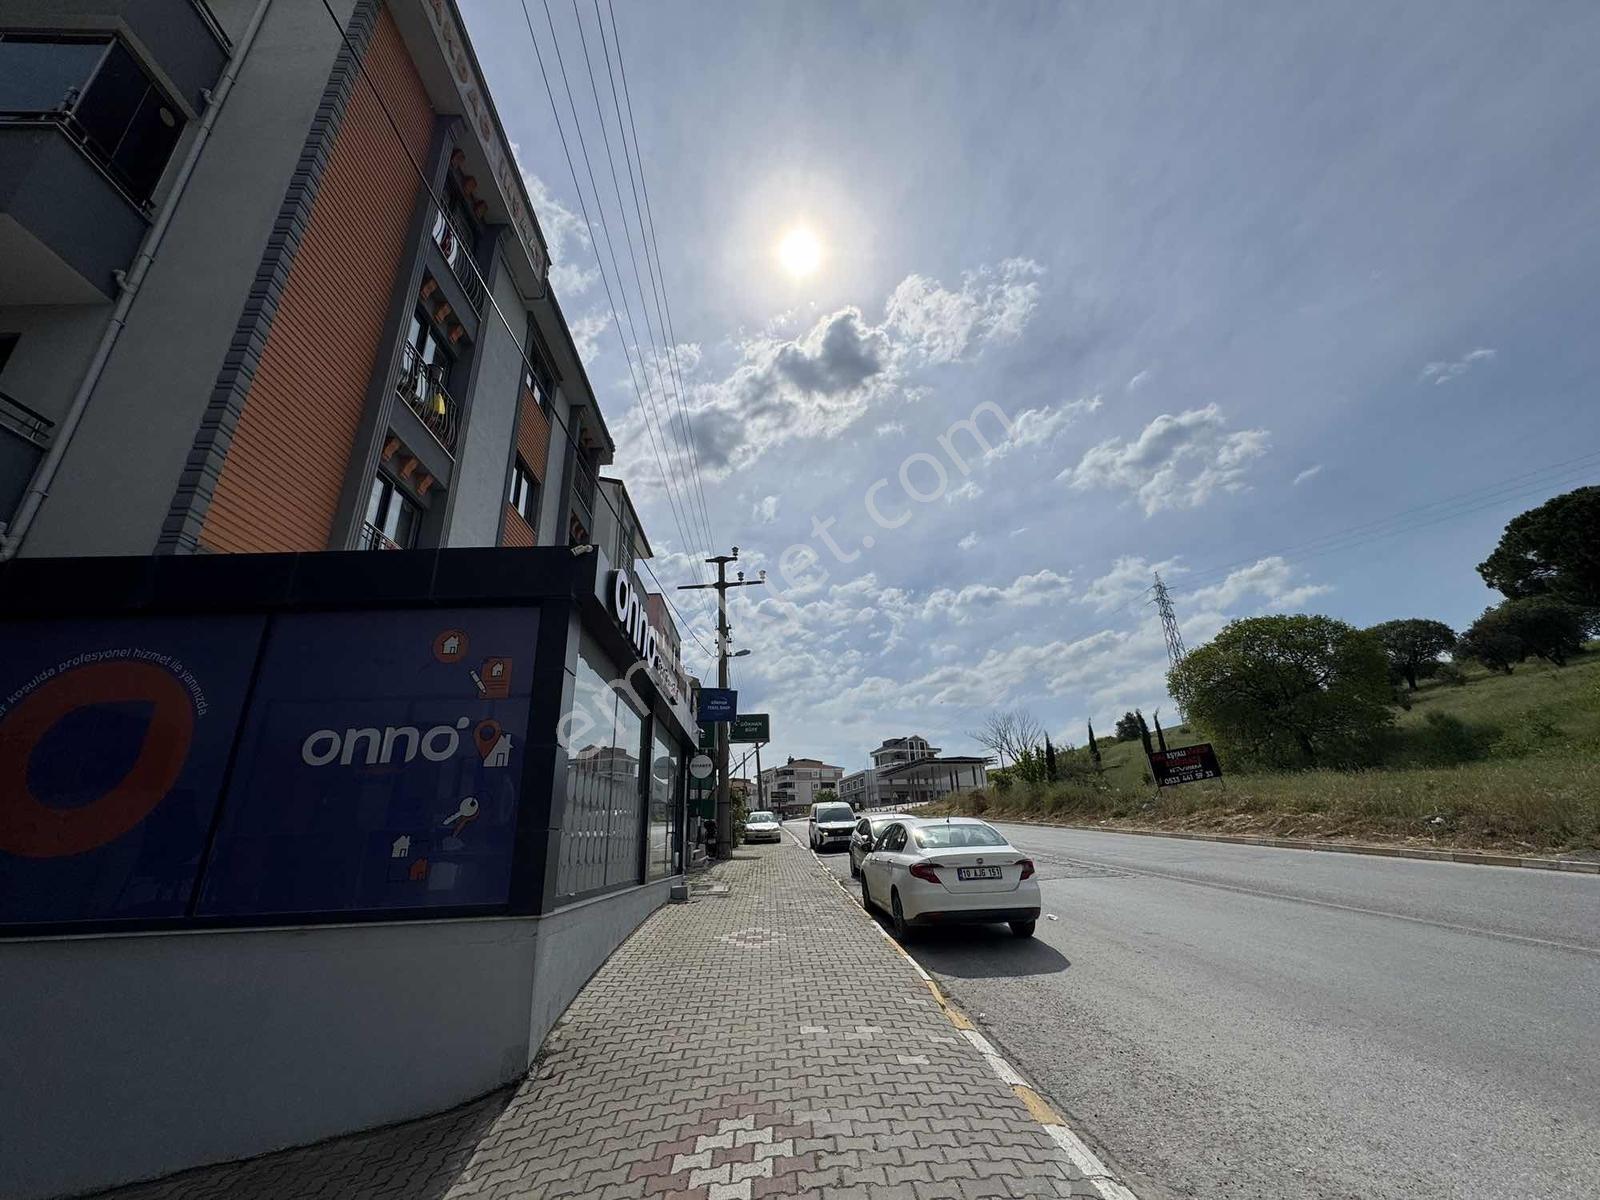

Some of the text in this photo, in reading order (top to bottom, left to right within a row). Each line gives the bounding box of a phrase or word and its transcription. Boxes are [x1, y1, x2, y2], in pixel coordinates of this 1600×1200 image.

[58, 647, 132, 673] profesyonel
[133, 647, 171, 667] hizmet
[169, 658, 183, 673] ile
[179, 669, 209, 717] yanınızda
[300, 716, 472, 767] onno
[962, 869, 971, 878] 10
[988, 867, 1000, 876] 151
